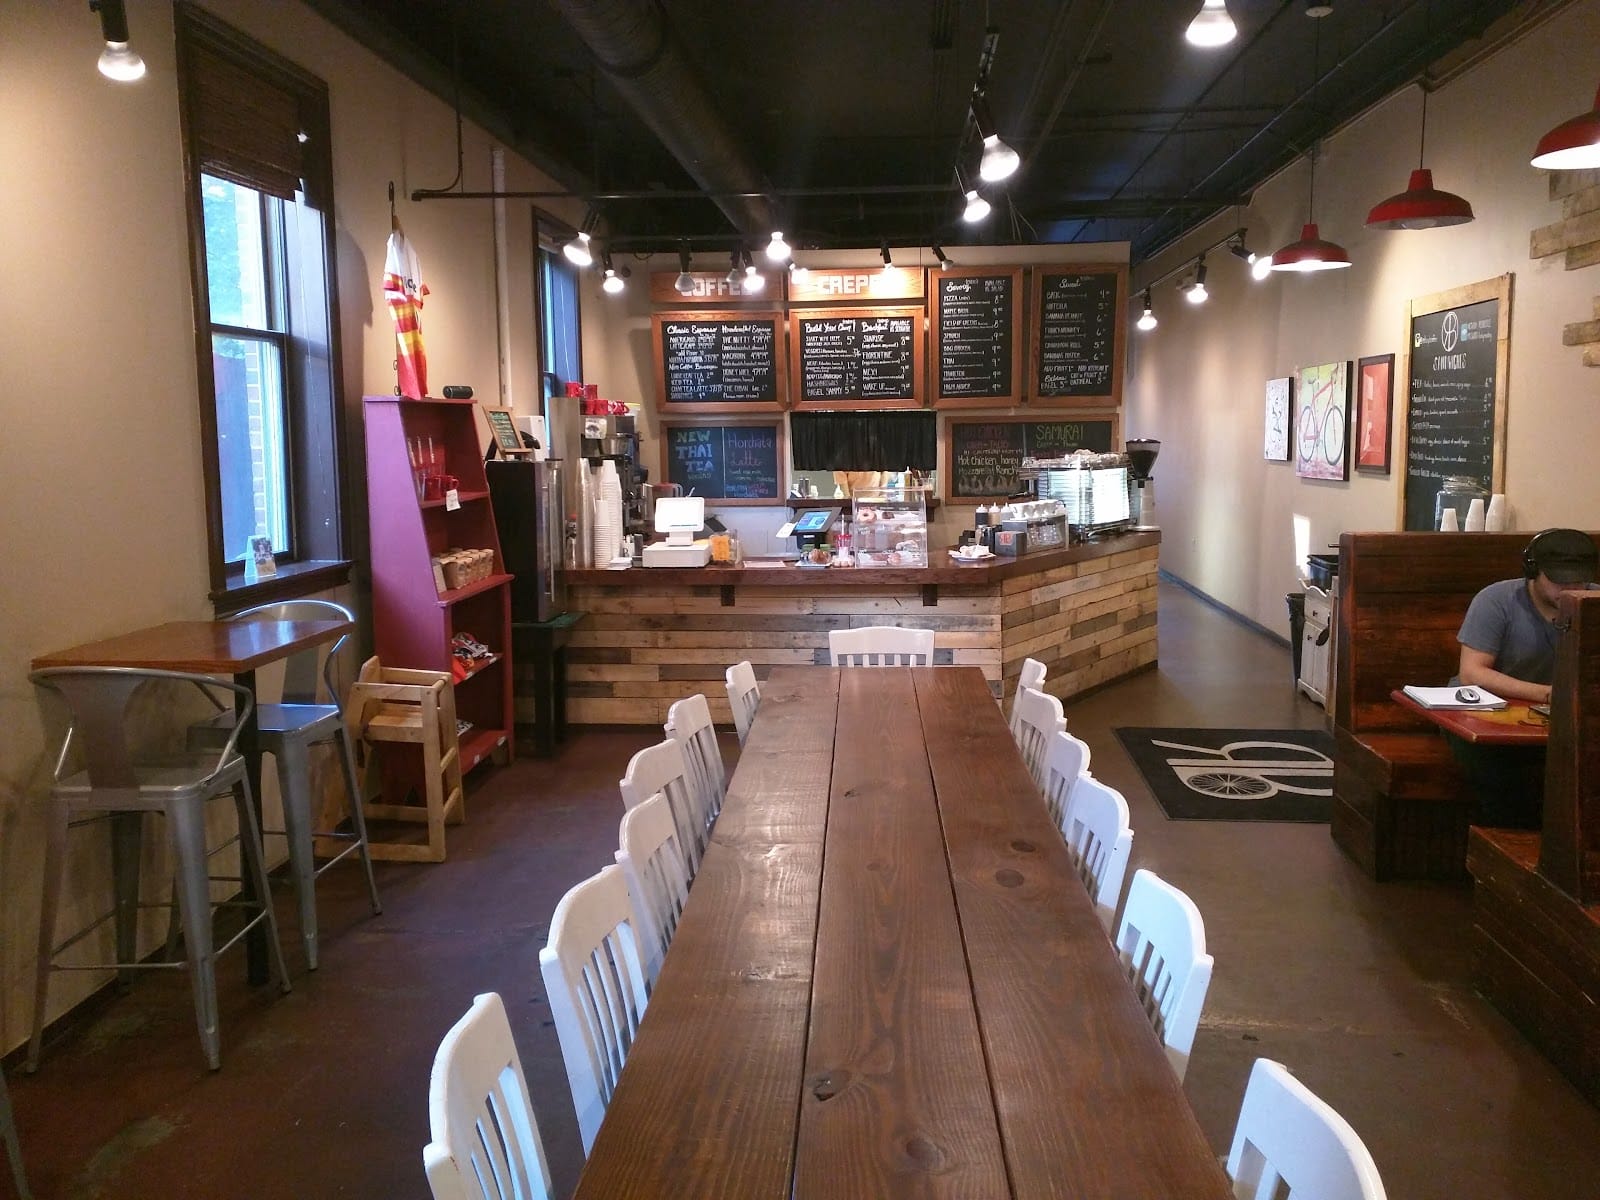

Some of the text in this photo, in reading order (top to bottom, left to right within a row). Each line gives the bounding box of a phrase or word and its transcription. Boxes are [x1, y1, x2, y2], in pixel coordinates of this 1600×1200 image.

[805, 322, 822, 334] Build
[824, 322, 837, 334] Your
[863, 334, 885, 343] SUNRISE
[862, 383, 878, 391] WAKE
[677, 430, 711, 443] NEW
[1036, 424, 1084, 441] SAMURAI
[675, 444, 713, 459] THAI
[685, 460, 715, 473] TEA
[957, 456, 970, 466] Hot
